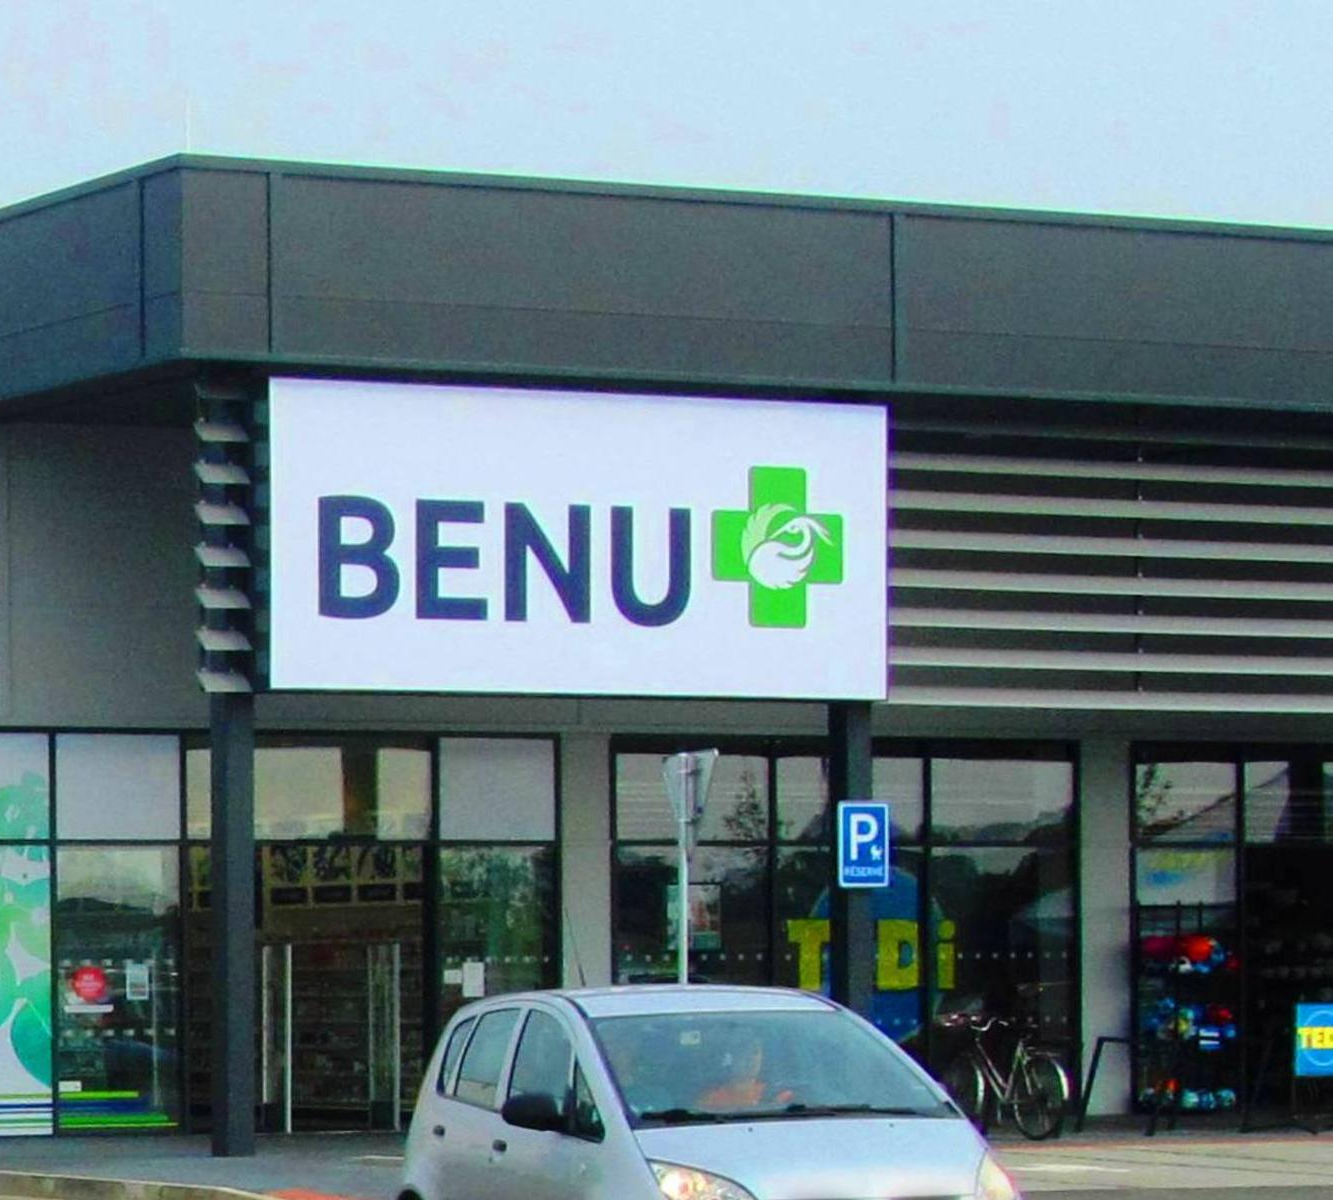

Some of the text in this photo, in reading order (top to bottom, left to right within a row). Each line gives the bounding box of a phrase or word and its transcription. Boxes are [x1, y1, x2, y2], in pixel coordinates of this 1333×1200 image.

[316, 492, 692, 629] BENU
[849, 812, 879, 862] P
[786, 918, 956, 991] TDi
